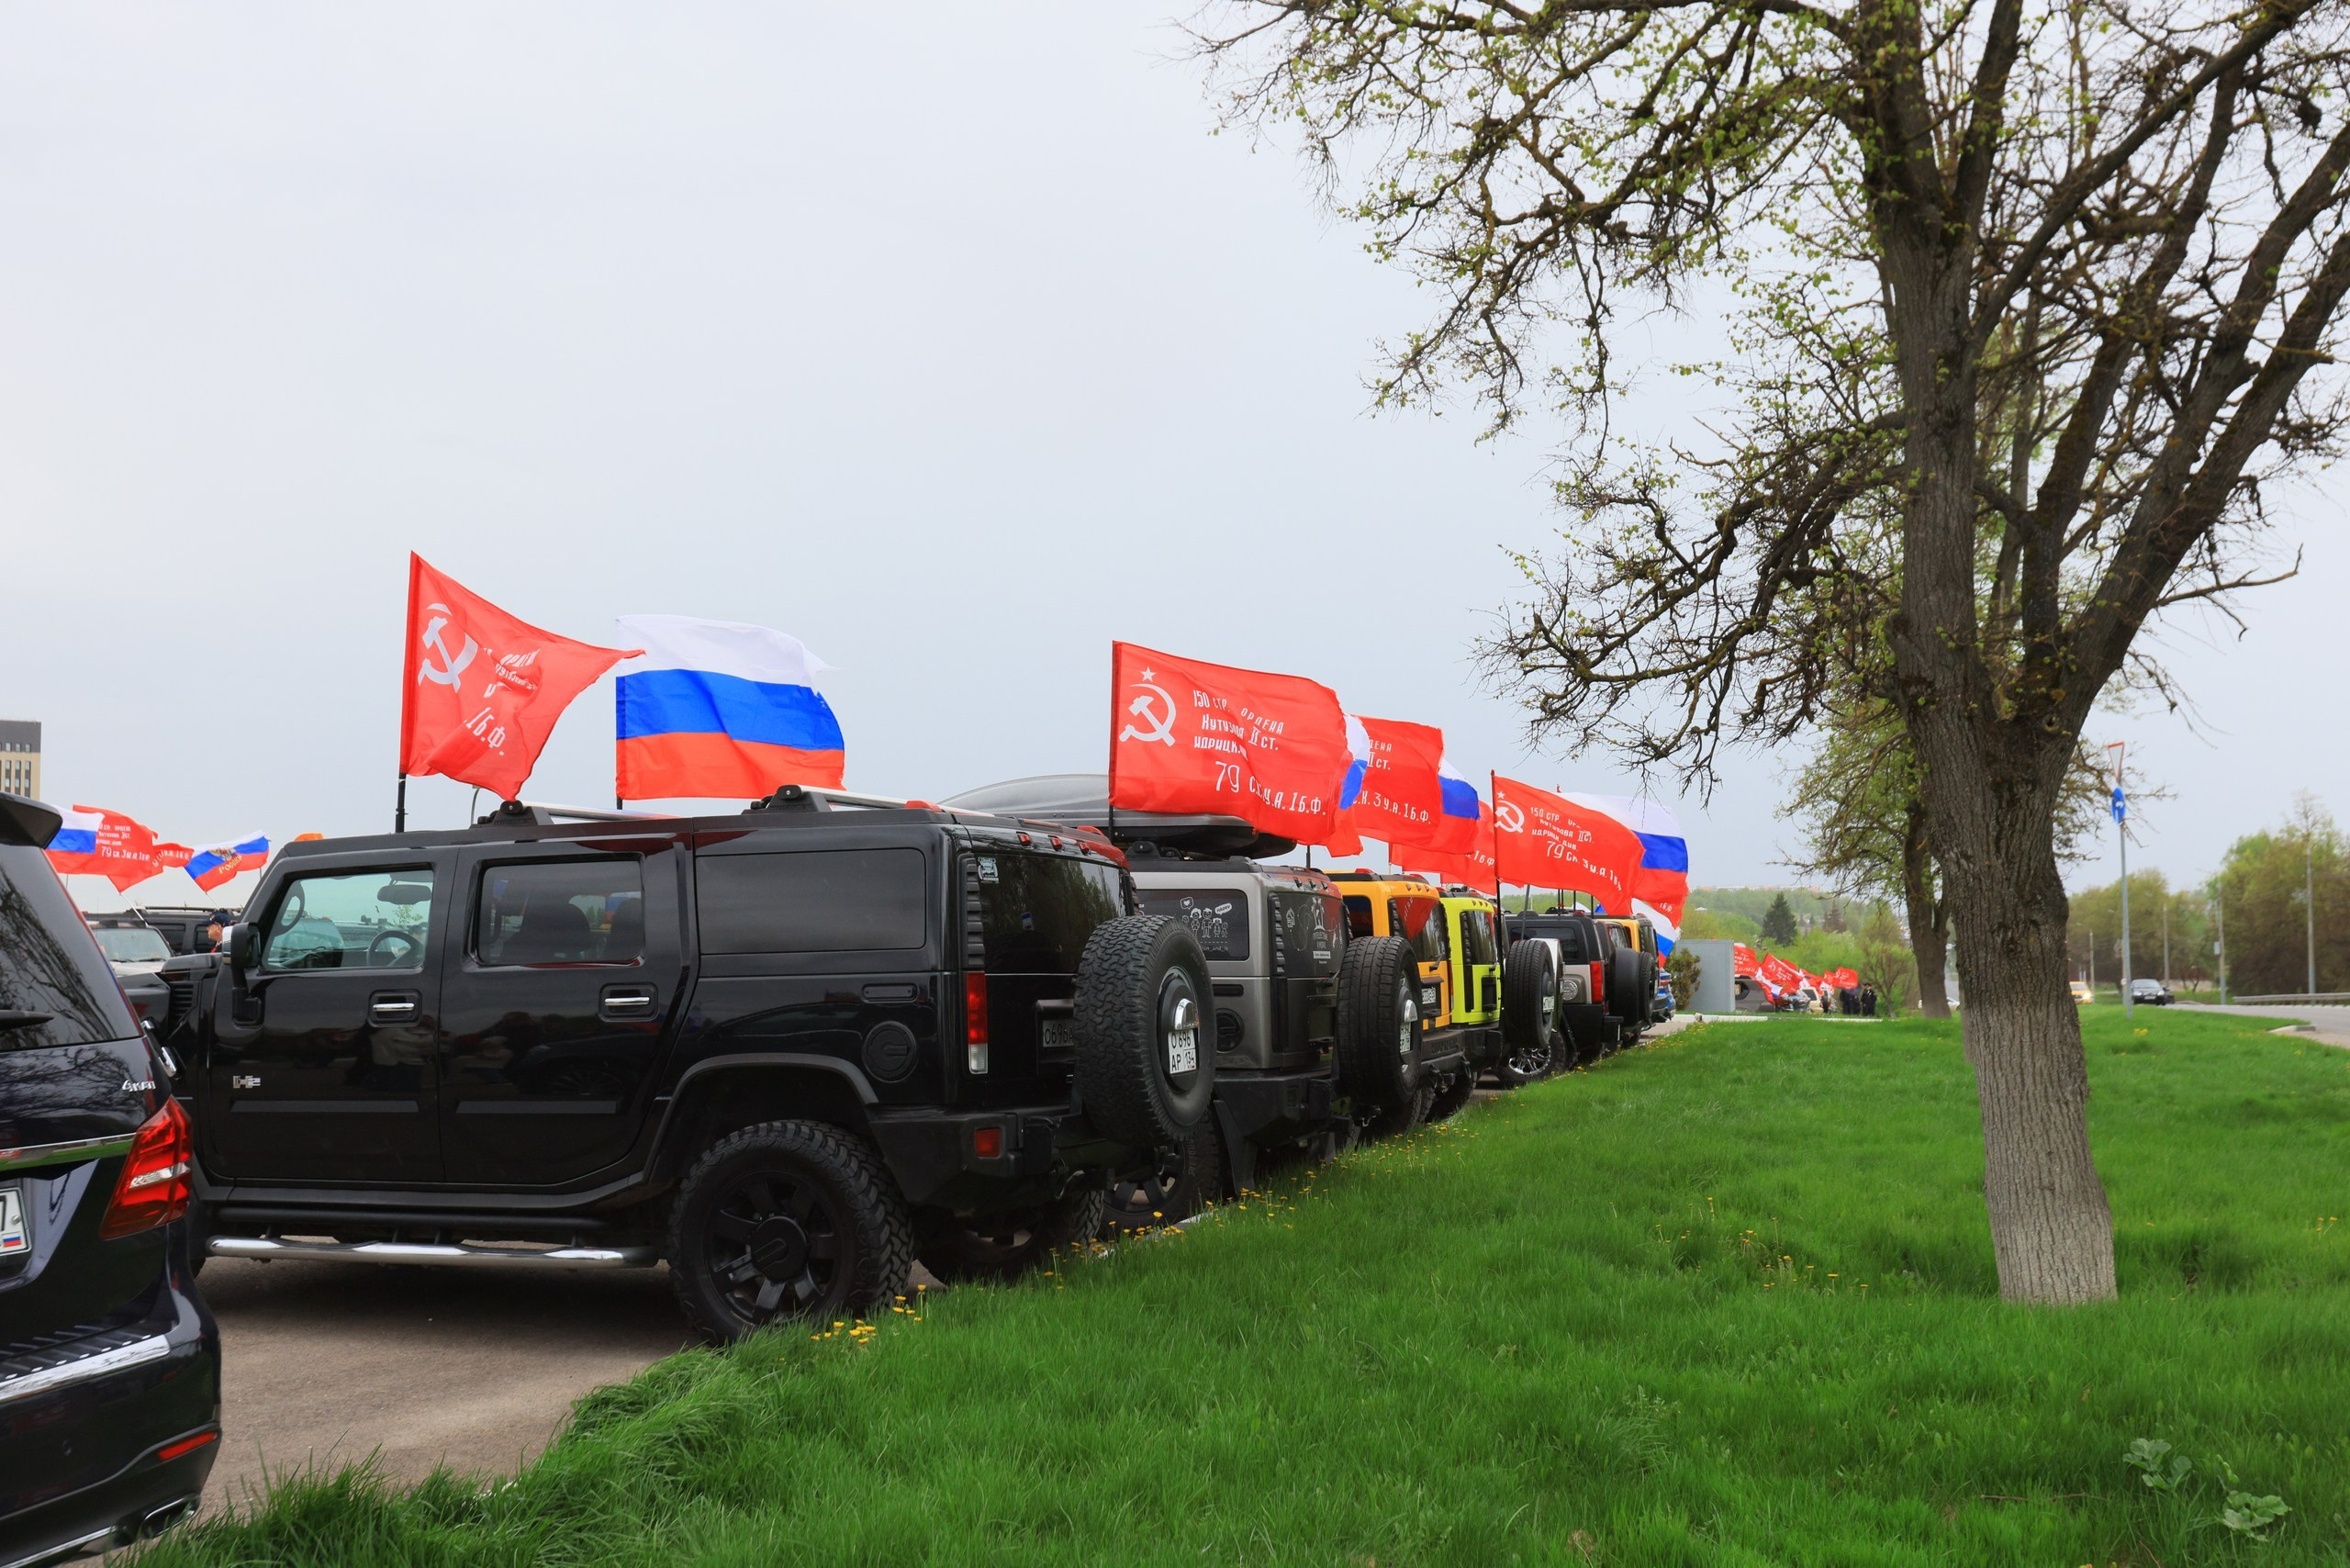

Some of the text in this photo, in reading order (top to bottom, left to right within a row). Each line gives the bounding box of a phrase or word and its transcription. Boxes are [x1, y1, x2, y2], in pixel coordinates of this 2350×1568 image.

[1193, 690, 1210, 708] 150
[1240, 708, 1284, 734] ОРДЕНА
[1215, 761, 1240, 793] 79
[1530, 807, 1543, 817] 150
[1547, 841, 1565, 858] 79
